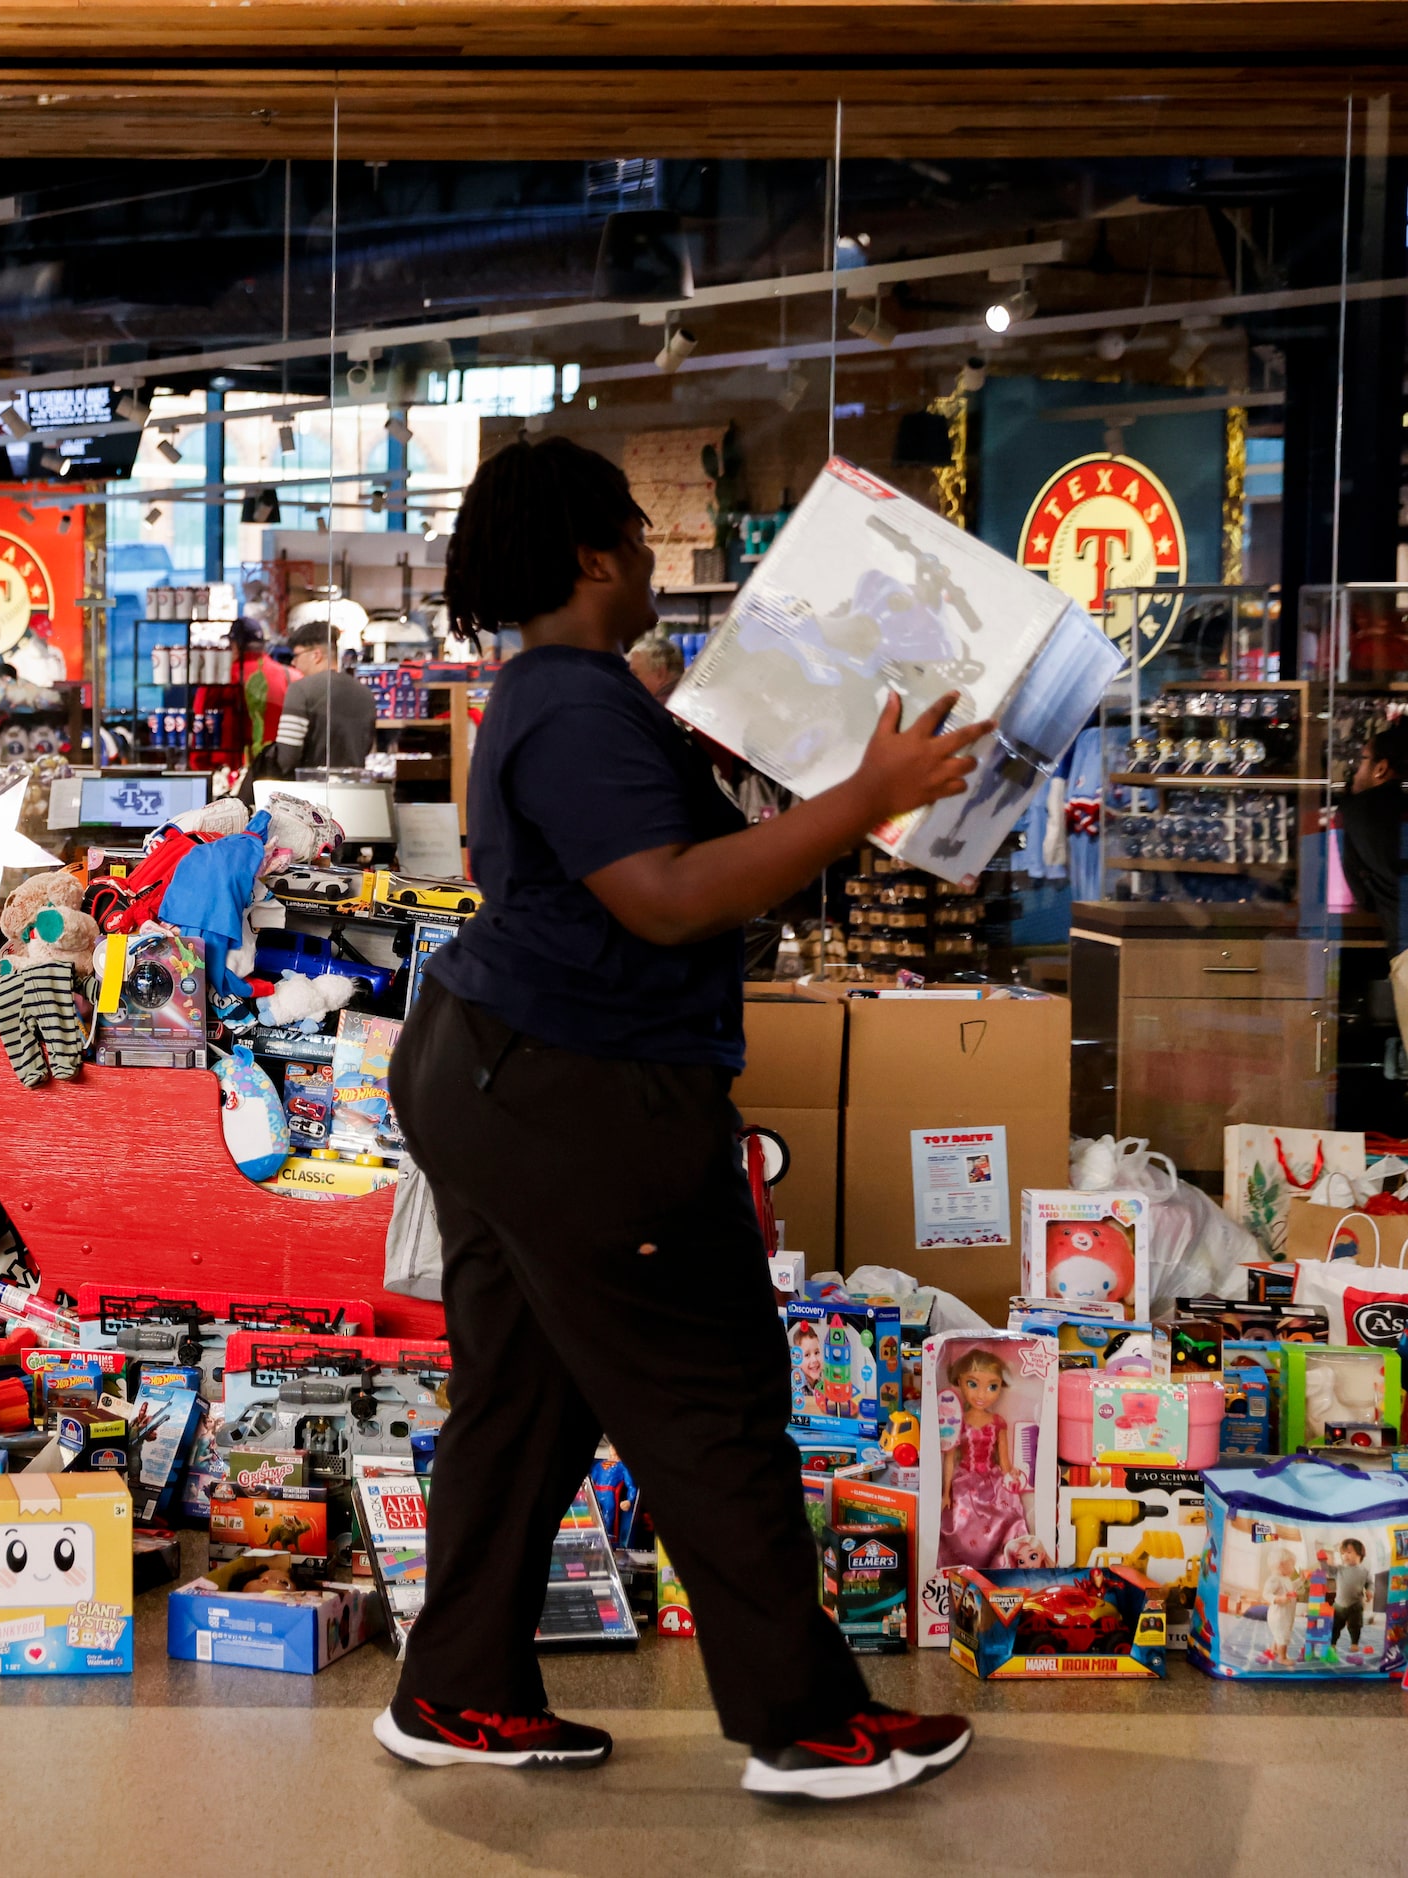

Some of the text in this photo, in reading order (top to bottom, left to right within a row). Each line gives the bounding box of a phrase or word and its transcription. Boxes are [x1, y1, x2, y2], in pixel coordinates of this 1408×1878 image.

[1044, 469, 1163, 523] TEXAS
[1077, 529, 1129, 612] T
[285, 901, 319, 909] Lamborghini
[340, 1089, 358, 1100] HOT
[923, 1133, 993, 1144] TOY DRIVE
[282, 1169, 335, 1184] CLASSIC
[1038, 1211, 1059, 1219] AND
[791, 1304, 825, 1316] Discovery
[150, 1375, 164, 1386] HOT
[1183, 1372, 1211, 1381] EXTREME
[57, 1378, 70, 1388] HOT
[262, 1462, 268, 1470] A
[239, 1464, 293, 1486] CHRISTMAS
[381, 1486, 417, 1494] STORE
[385, 1496, 422, 1513] ART
[115, 1506, 126, 1515] 3+
[371, 1496, 386, 1529] STACK
[390, 1512, 424, 1528] SET
[852, 1557, 894, 1567] ELMER'S
[77, 1602, 121, 1618] GIANT
[68, 1615, 124, 1633] MYSTERY
[87, 1658, 114, 1666] Walmart
[1026, 1658, 1118, 1671] MARVEL IRON MAN
